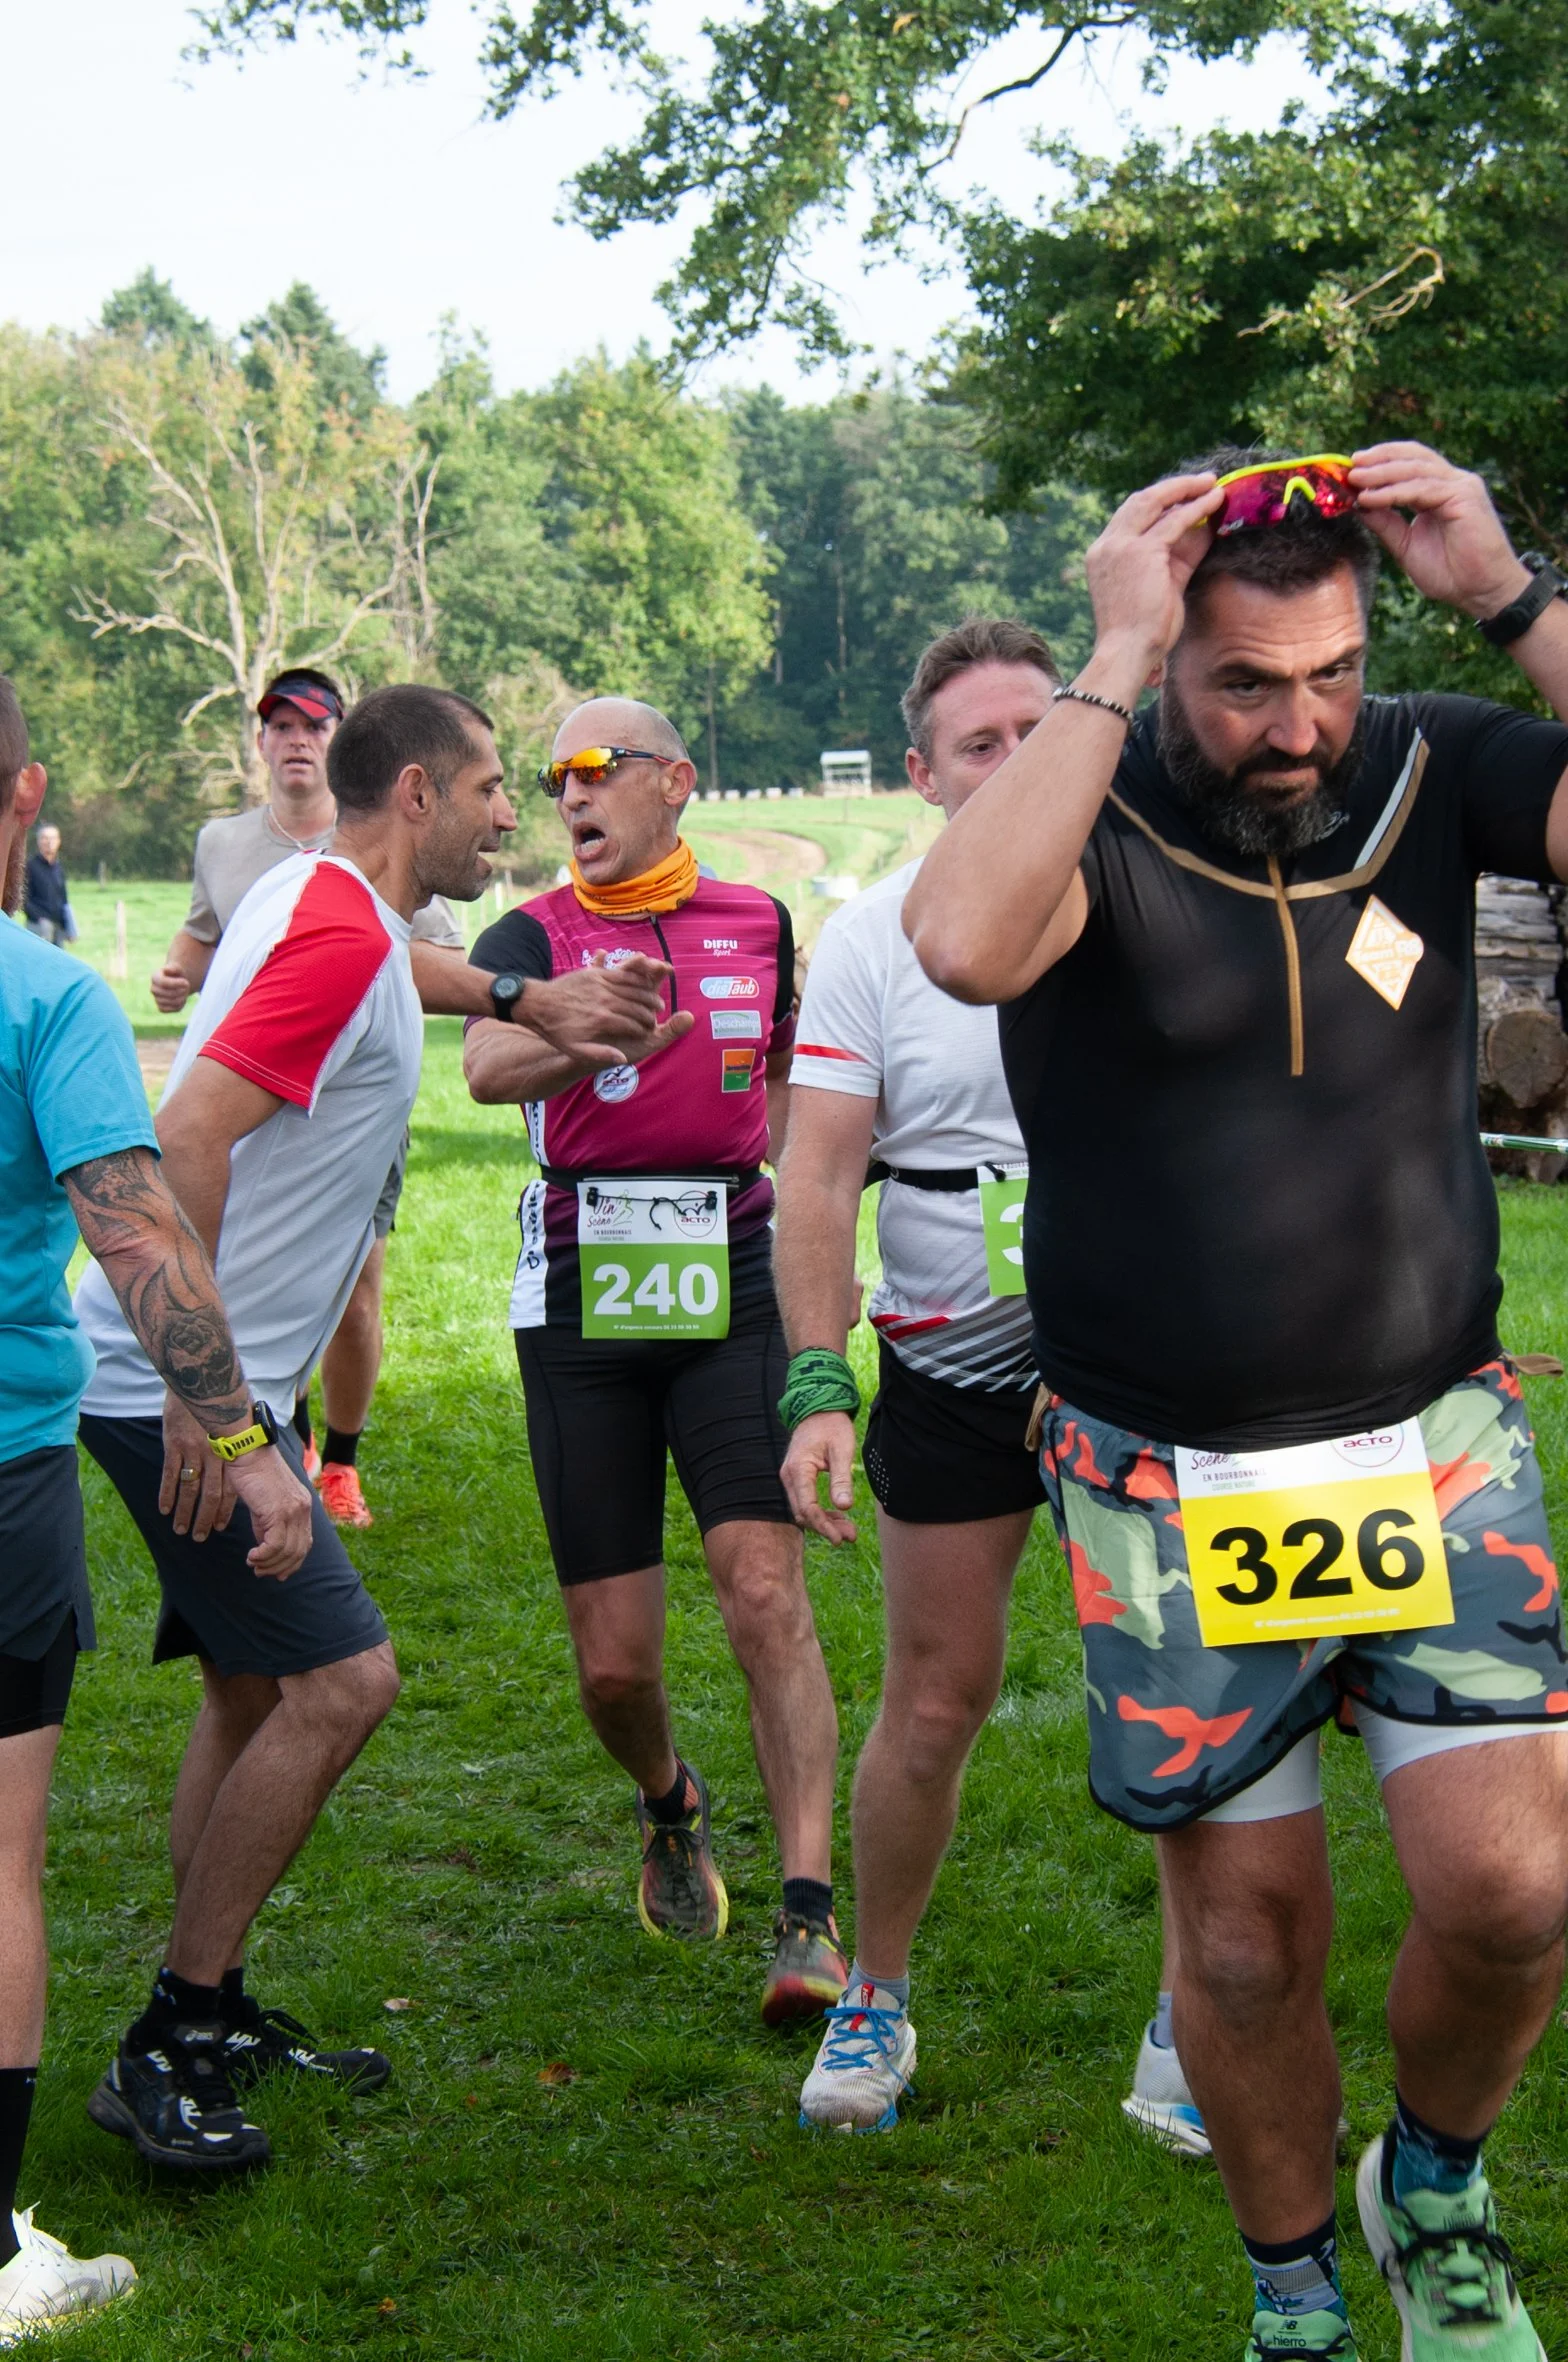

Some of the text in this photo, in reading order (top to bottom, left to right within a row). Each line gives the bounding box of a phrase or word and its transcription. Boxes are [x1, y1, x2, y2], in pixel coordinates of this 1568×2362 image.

[703, 939, 738, 949] DIFFU
[592, 1263, 719, 1316] 240
[1202, 1473, 1212, 1482] EN
[1209, 1508, 1425, 1606] 326
[1273, 2334, 1307, 2347] hierro
